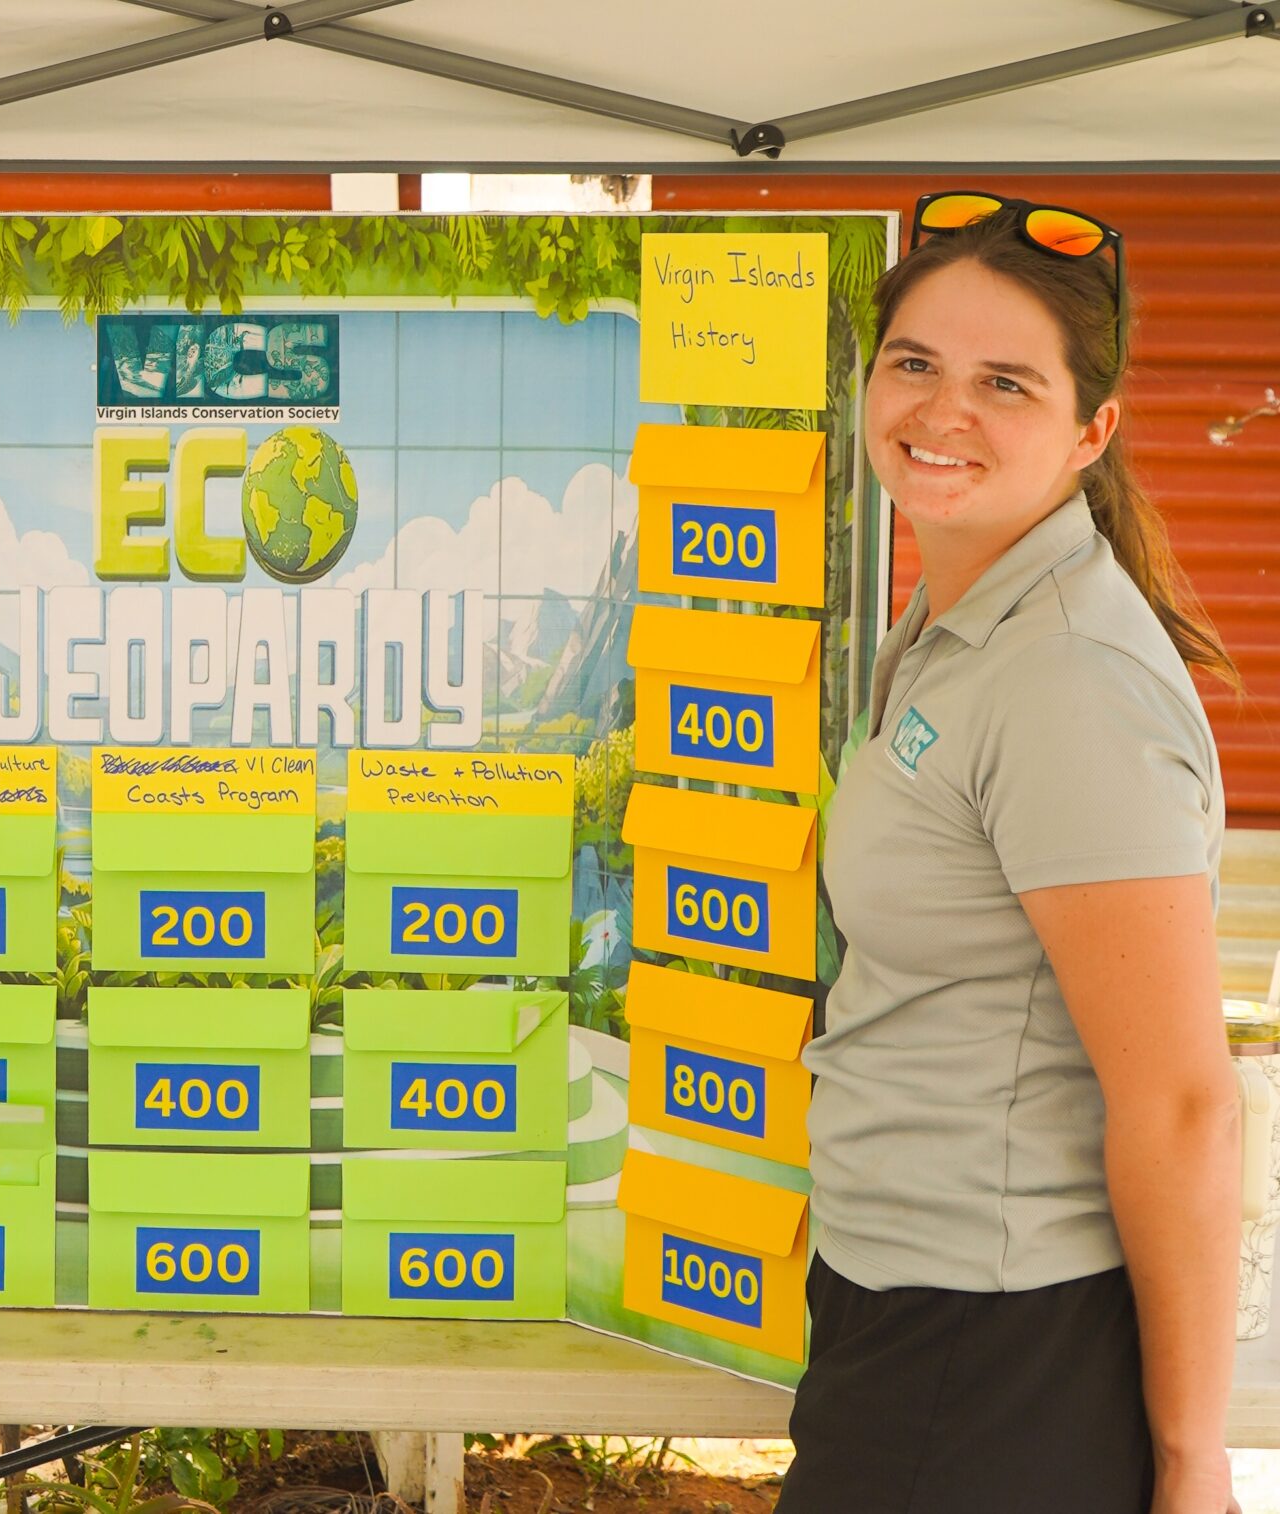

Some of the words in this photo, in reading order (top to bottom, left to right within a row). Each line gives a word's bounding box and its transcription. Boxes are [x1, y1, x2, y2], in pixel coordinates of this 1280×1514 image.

[654, 252, 715, 304] Virgin
[727, 250, 816, 289] Islands
[106, 322, 330, 400] VICS
[671, 320, 756, 365] History
[97, 406, 137, 420] Virgin
[140, 406, 188, 419] Islands
[191, 406, 284, 419] Conservation
[287, 406, 340, 420] Society
[681, 520, 766, 569] 200
[677, 703, 764, 753] 400
[245, 755, 265, 774] VI
[271, 756, 315, 775] Clean
[360, 757, 437, 778] Waste
[453, 767, 465, 778] +
[471, 760, 563, 784] Pollution
[126, 784, 206, 805] Coasts
[217, 781, 300, 809] Program
[387, 788, 499, 808] Prevention
[152, 906, 253, 947] 200
[402, 902, 505, 945] 200
[675, 883, 759, 937] 600
[145, 1079, 249, 1120] 400
[400, 1079, 505, 1120] 400
[672, 1064, 756, 1122] 800
[147, 1242, 250, 1284] 600
[400, 1248, 504, 1289] 600
[664, 1248, 759, 1306] 1000
